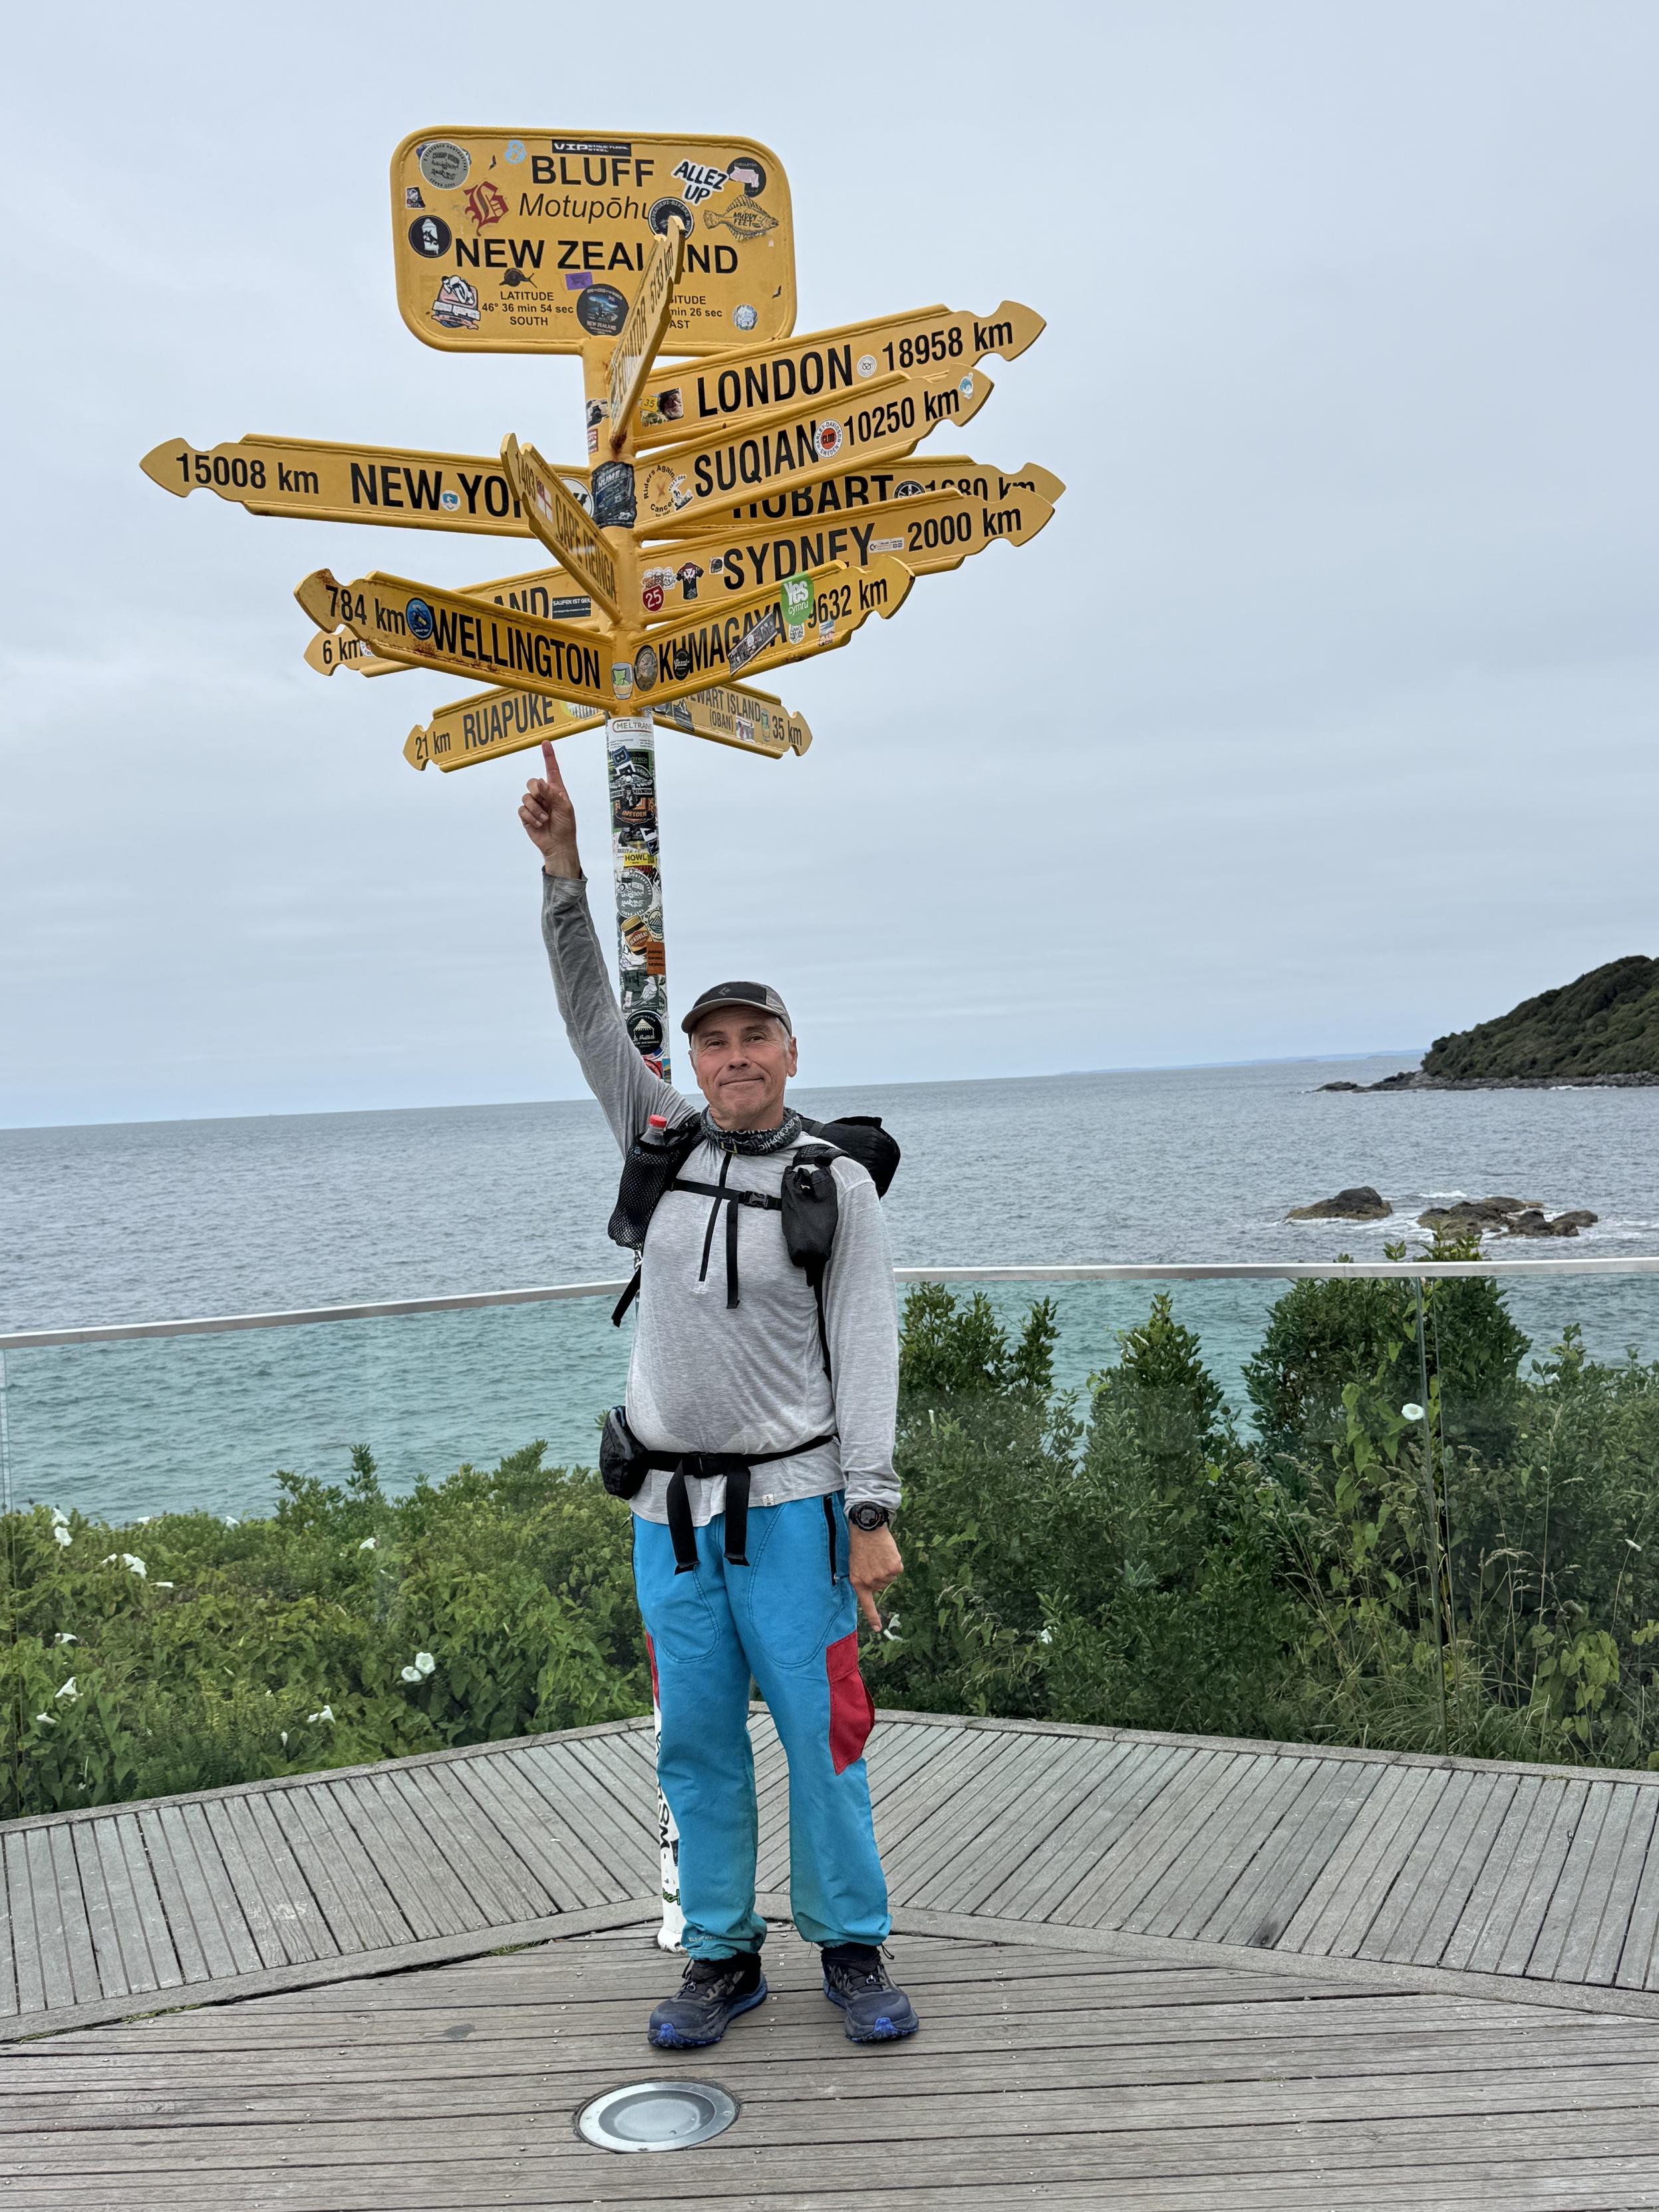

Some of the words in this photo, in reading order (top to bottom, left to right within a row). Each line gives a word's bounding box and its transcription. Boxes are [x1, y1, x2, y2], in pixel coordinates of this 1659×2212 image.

[553, 142, 588, 151] VIP
[531, 155, 655, 188] BLUFF
[673, 161, 727, 190] ALLEZ
[519, 192, 650, 224] Motupōhu
[684, 184, 710, 204] UP
[733, 212, 758, 220] MUDDY
[733, 218, 752, 227] FEET
[455, 238, 545, 269] NEW
[557, 240, 738, 275] ZEAND
[500, 291, 554, 301] LATITUDE
[650, 258, 664, 314] 5133
[482, 303, 500, 312] 46°
[502, 303, 514, 313] 36
[517, 304, 537, 313] min
[540, 305, 552, 313] 54
[510, 316, 549, 326] SOUTH
[690, 308, 702, 317] 26
[669, 320, 690, 329] AST
[697, 344, 853, 418] LONDON
[882, 327, 963, 371] 18958
[973, 321, 1013, 352] km
[644, 398, 656, 408] 35
[694, 420, 820, 498] SUQIAN
[843, 396, 915, 446] 10250
[923, 389, 960, 422] km
[176, 453, 267, 490] 15008
[277, 462, 319, 495] km
[350, 462, 443, 511] NEW
[456, 472, 522, 519] YO
[656, 464, 677, 481] Again
[515, 450, 536, 502] 1403
[555, 493, 582, 567] CAPE
[733, 474, 895, 520] OBART
[722, 522, 875, 591] SYDNEY
[907, 511, 972, 552] 2000
[982, 507, 1022, 538] km
[645, 589, 662, 608] 25
[784, 580, 810, 606] Yes
[807, 584, 852, 629] 9632
[858, 577, 888, 611] km
[788, 601, 810, 615] cymru
[323, 639, 333, 665] 6
[339, 637, 363, 661] km
[325, 584, 367, 625] 784
[374, 597, 406, 636] km
[427, 604, 601, 690] WELLINGTON
[415, 734, 429, 760] 21
[432, 731, 452, 755] km
[463, 693, 555, 750] RUAPUKE
[709, 707, 734, 733] (OBAN)
[726, 692, 761, 722] ISLAND
[772, 715, 785, 741] 35
[787, 719, 802, 746] km
